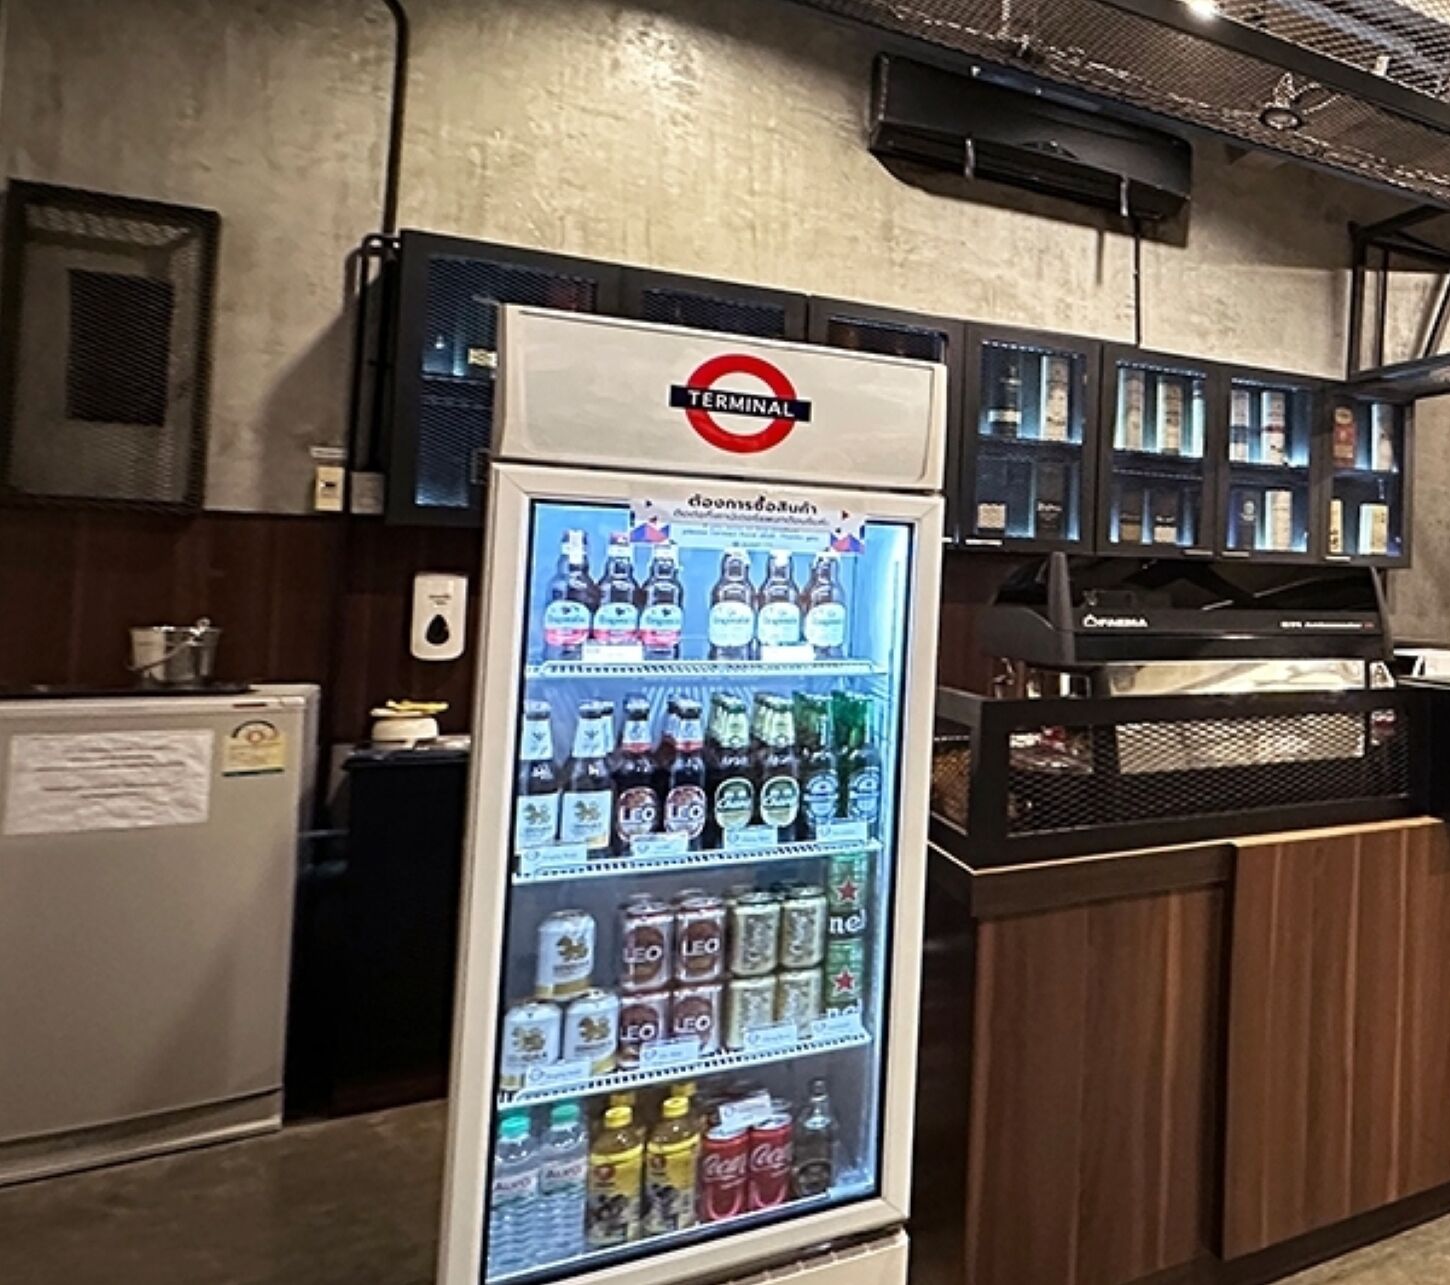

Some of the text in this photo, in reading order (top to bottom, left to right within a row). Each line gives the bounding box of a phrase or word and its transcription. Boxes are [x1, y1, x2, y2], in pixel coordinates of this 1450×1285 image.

[687, 388, 795, 418] TERMINAL
[687, 490, 818, 515] ต้องการซื้อสินค้า
[622, 945, 663, 963] LEO
[682, 937, 720, 955] LEO
